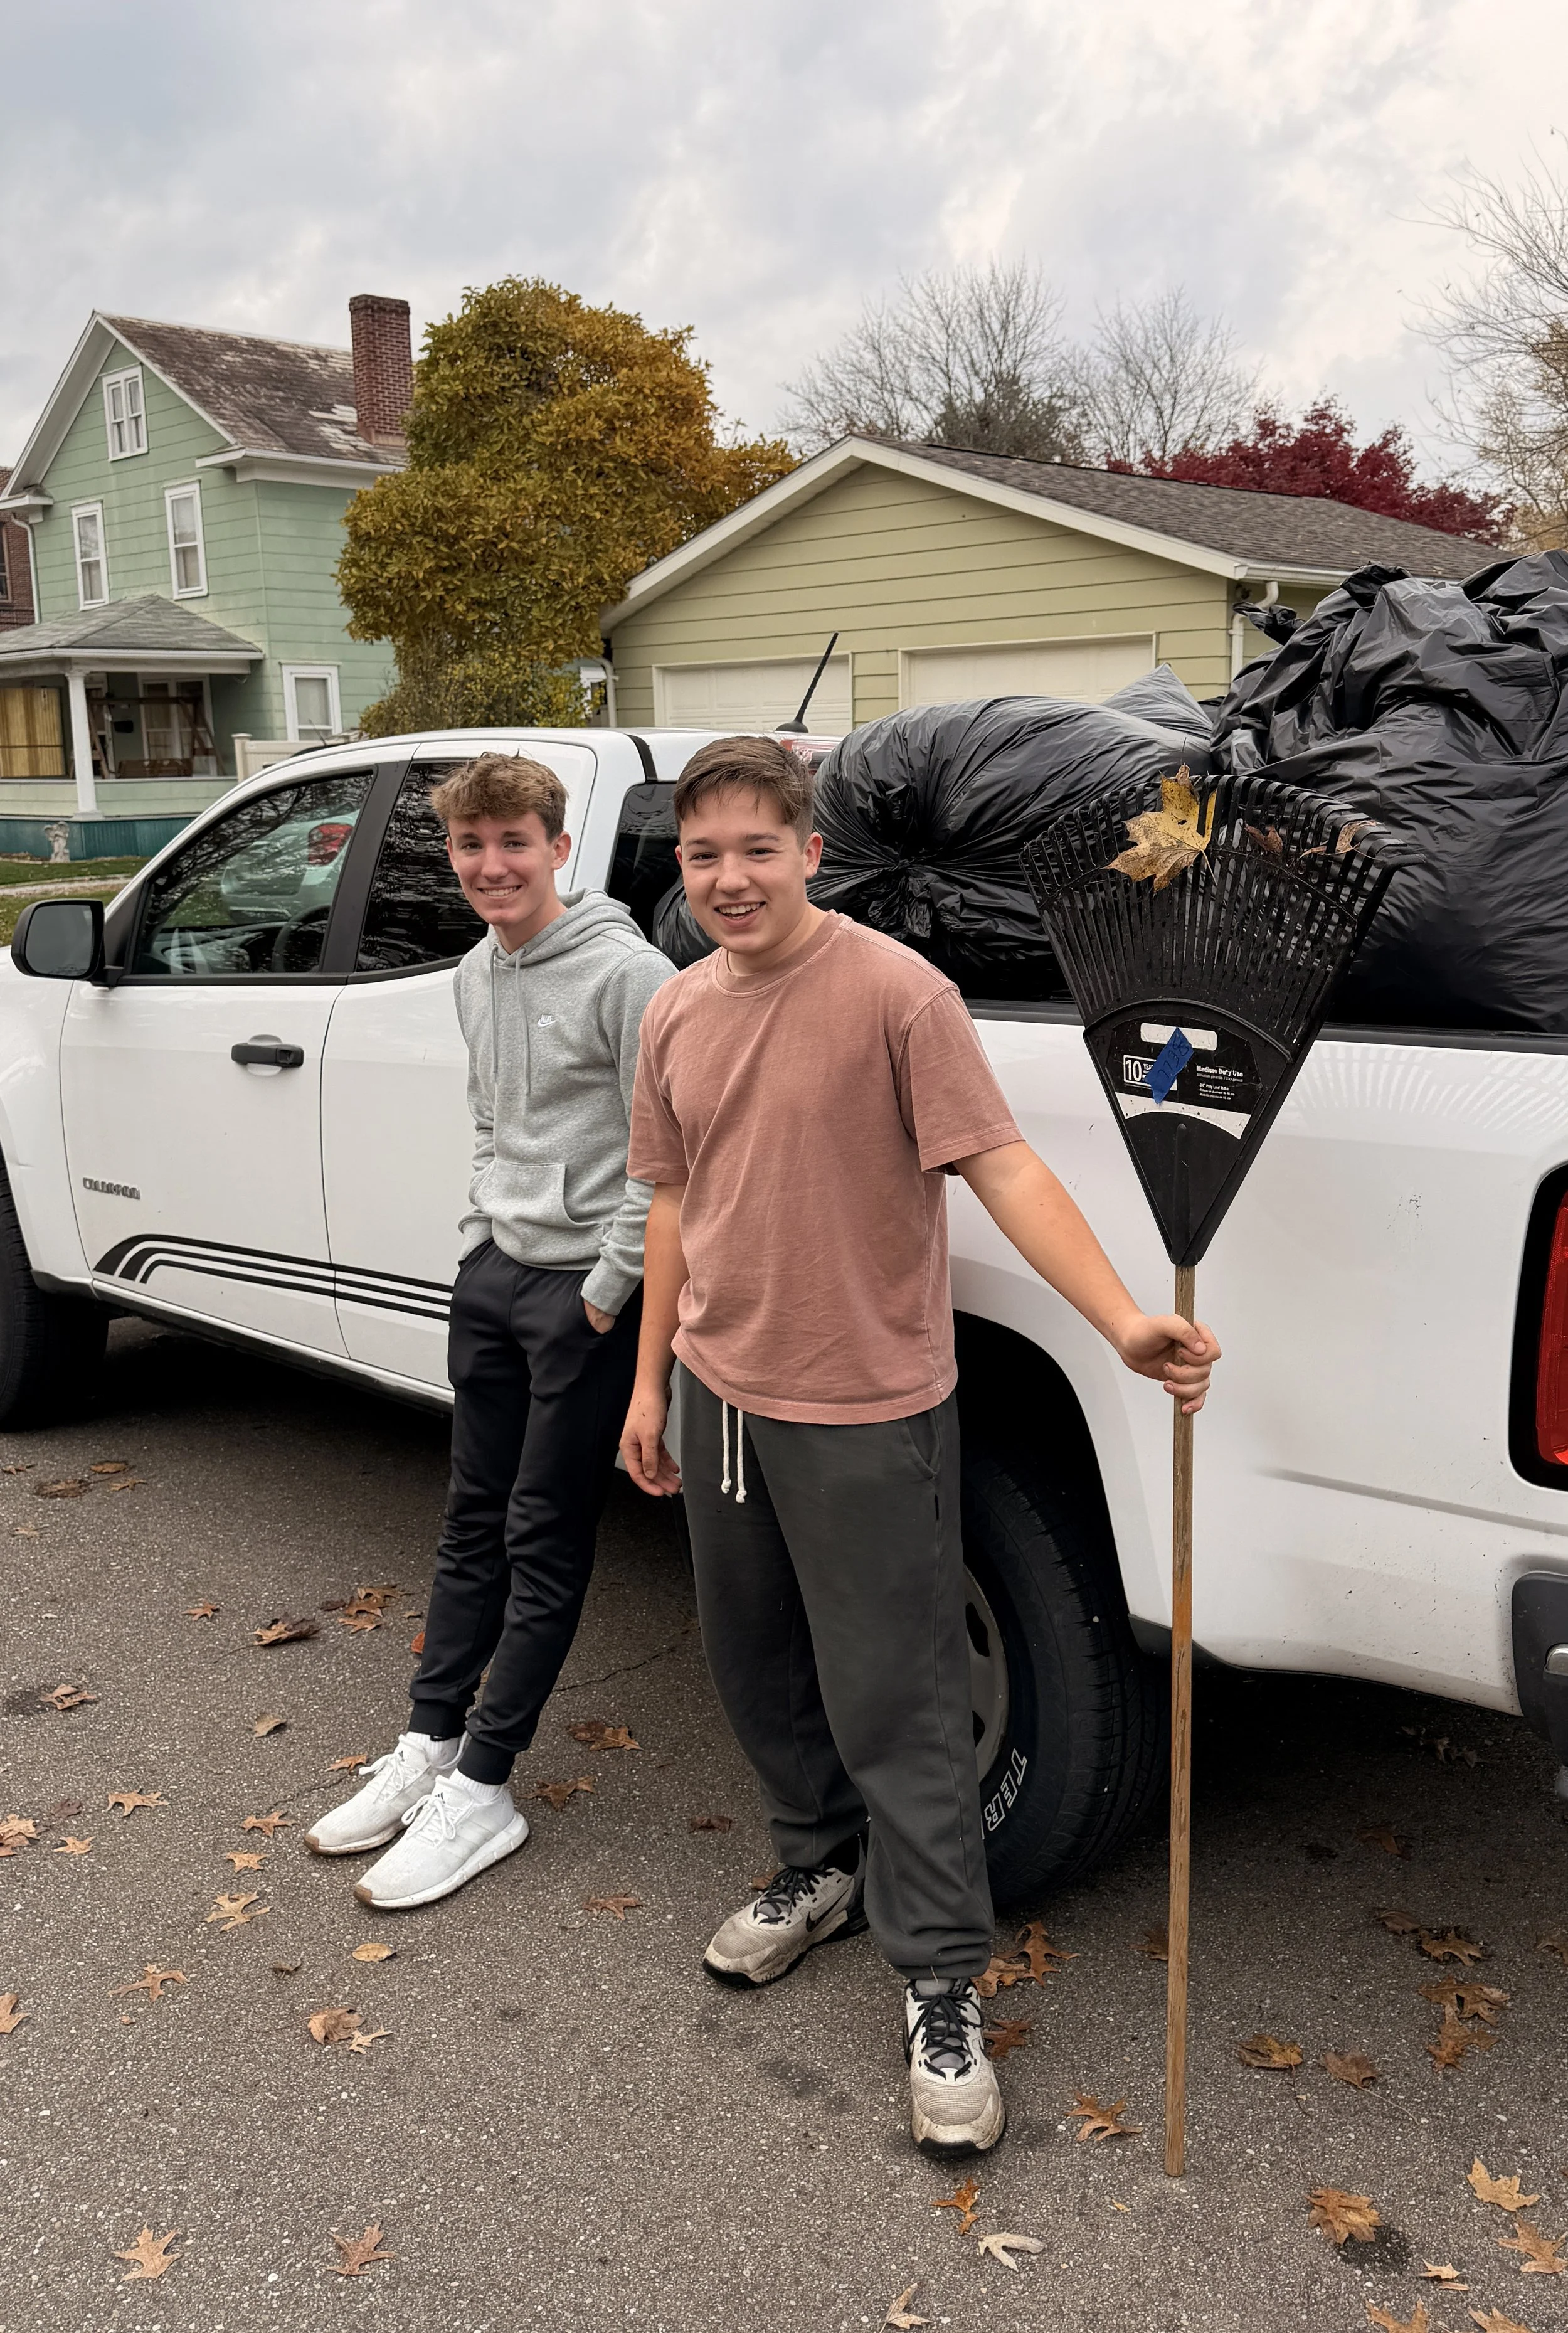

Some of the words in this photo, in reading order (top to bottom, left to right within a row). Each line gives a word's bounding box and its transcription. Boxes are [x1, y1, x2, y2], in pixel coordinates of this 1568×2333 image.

[1126, 1060, 1142, 1081] 10
[1218, 1068, 1232, 1076] Duty
[981, 1748, 1027, 1840] TER
